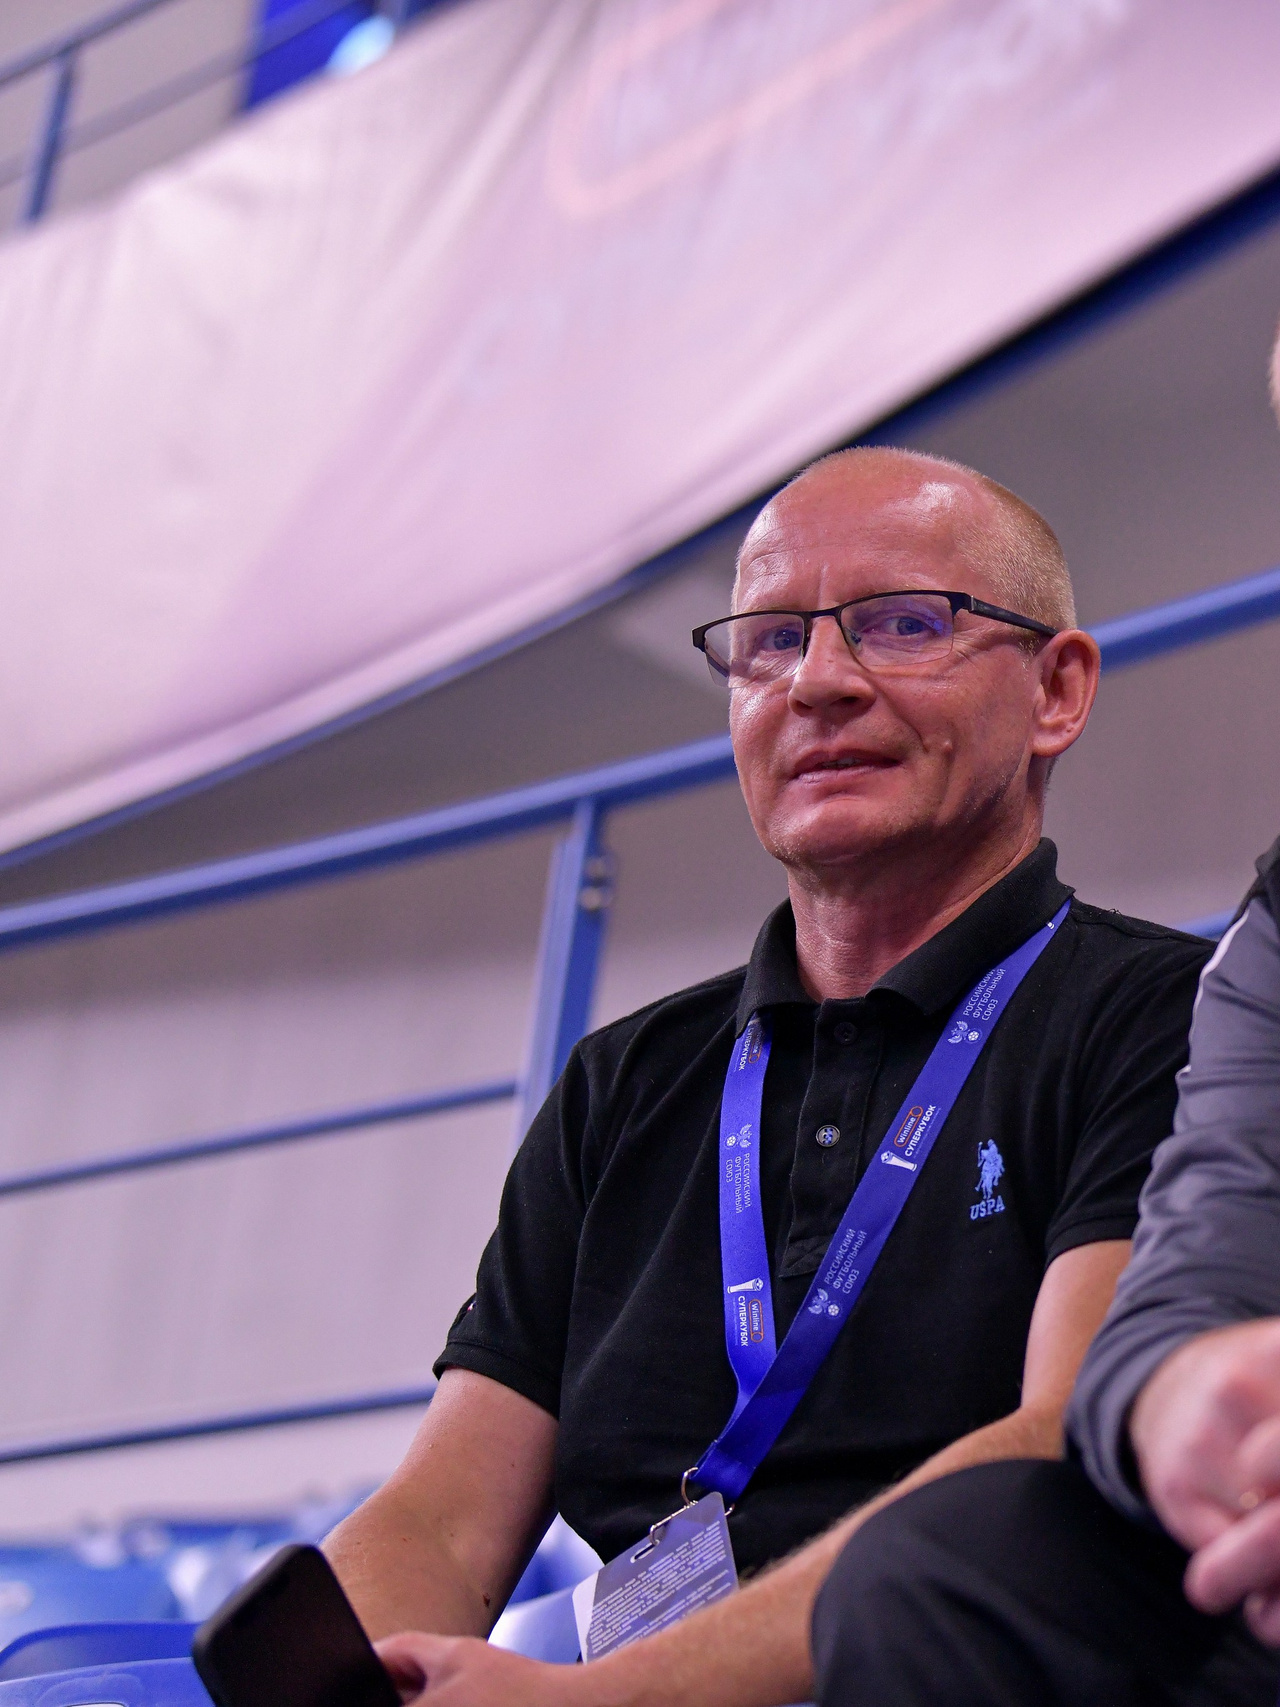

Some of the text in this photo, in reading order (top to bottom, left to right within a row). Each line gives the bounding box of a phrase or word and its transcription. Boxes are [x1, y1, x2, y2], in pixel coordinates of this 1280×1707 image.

[972, 967, 1007, 1019] ФУТБОЛЬНЫЙ
[981, 998, 999, 1022] СОЮЗ
[897, 1116, 917, 1144] Winline
[904, 1104, 937, 1158] СУПЕРКУБОК
[725, 1158, 734, 1184] СОЮЗ
[734, 1155, 745, 1214] ФУТБОЛЬНЫЙ
[743, 1152, 753, 1209] РОССИЙСКИЙ
[969, 1194, 1006, 1222] USPA
[823, 1227, 857, 1285] РОССИЙСКИЙ
[832, 1229, 868, 1290] ФУТБОЛЬНЫЙ
[841, 1268, 860, 1295] СОЮЗ
[737, 1295, 749, 1347] СУПЕРКУБОК
[751, 1302, 761, 1332] Winline
